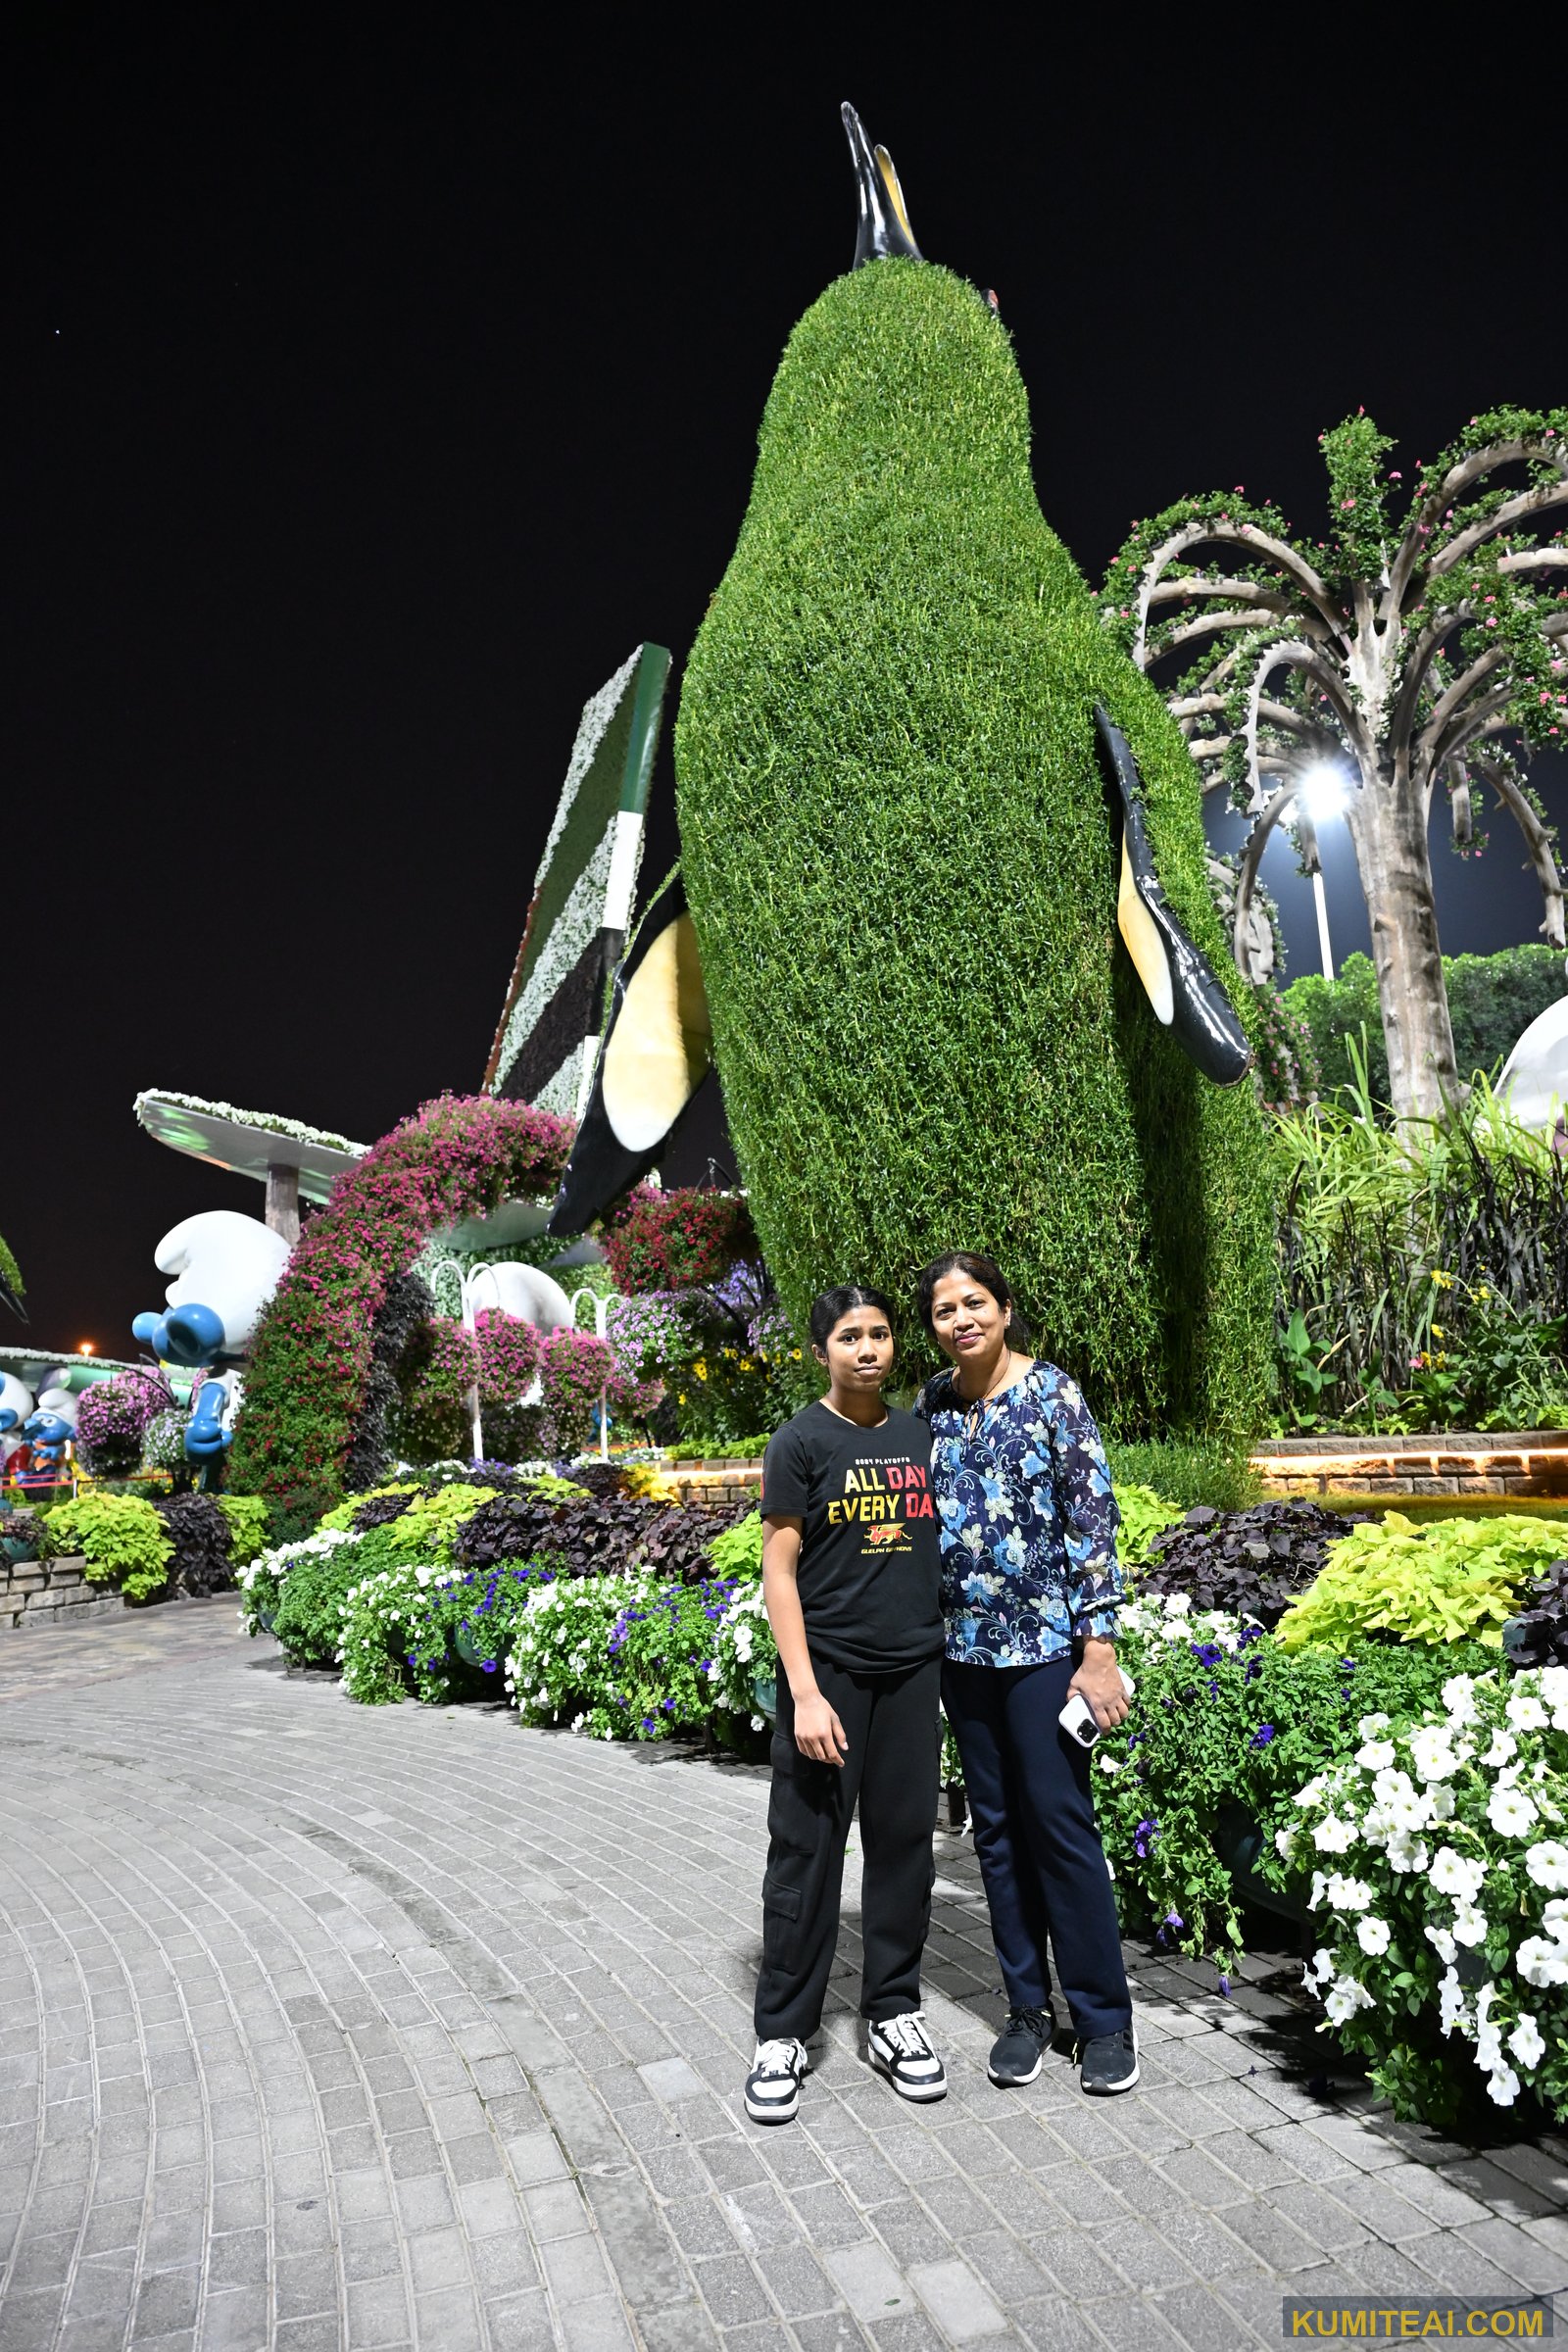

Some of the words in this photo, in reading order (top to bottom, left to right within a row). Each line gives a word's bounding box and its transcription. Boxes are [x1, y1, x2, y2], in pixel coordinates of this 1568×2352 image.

[844, 1468, 885, 1494] ALL
[886, 1465, 927, 1490] DAY
[828, 1494, 900, 1525] EVERY
[906, 1493, 934, 1519] DA
